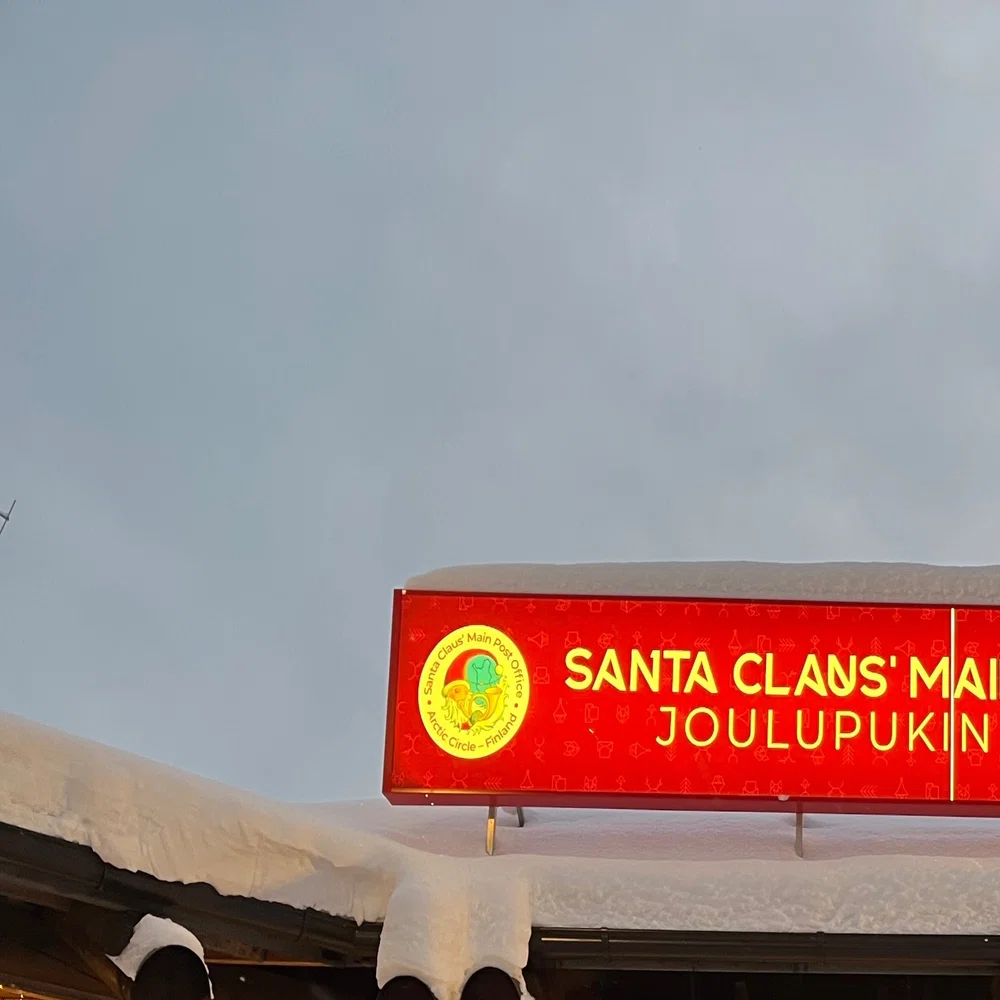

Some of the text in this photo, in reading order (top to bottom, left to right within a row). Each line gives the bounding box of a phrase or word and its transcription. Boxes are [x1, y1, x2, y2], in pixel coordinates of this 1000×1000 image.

[424, 632, 524, 698] Santa Claus' Main Post Office
[564, 647, 719, 694] SANTA
[427, 710, 449, 741] Arctic
[448, 736, 476, 752] Circle
[485, 712, 517, 748] Finland
[655, 706, 989, 754] JOULUPUKIN
